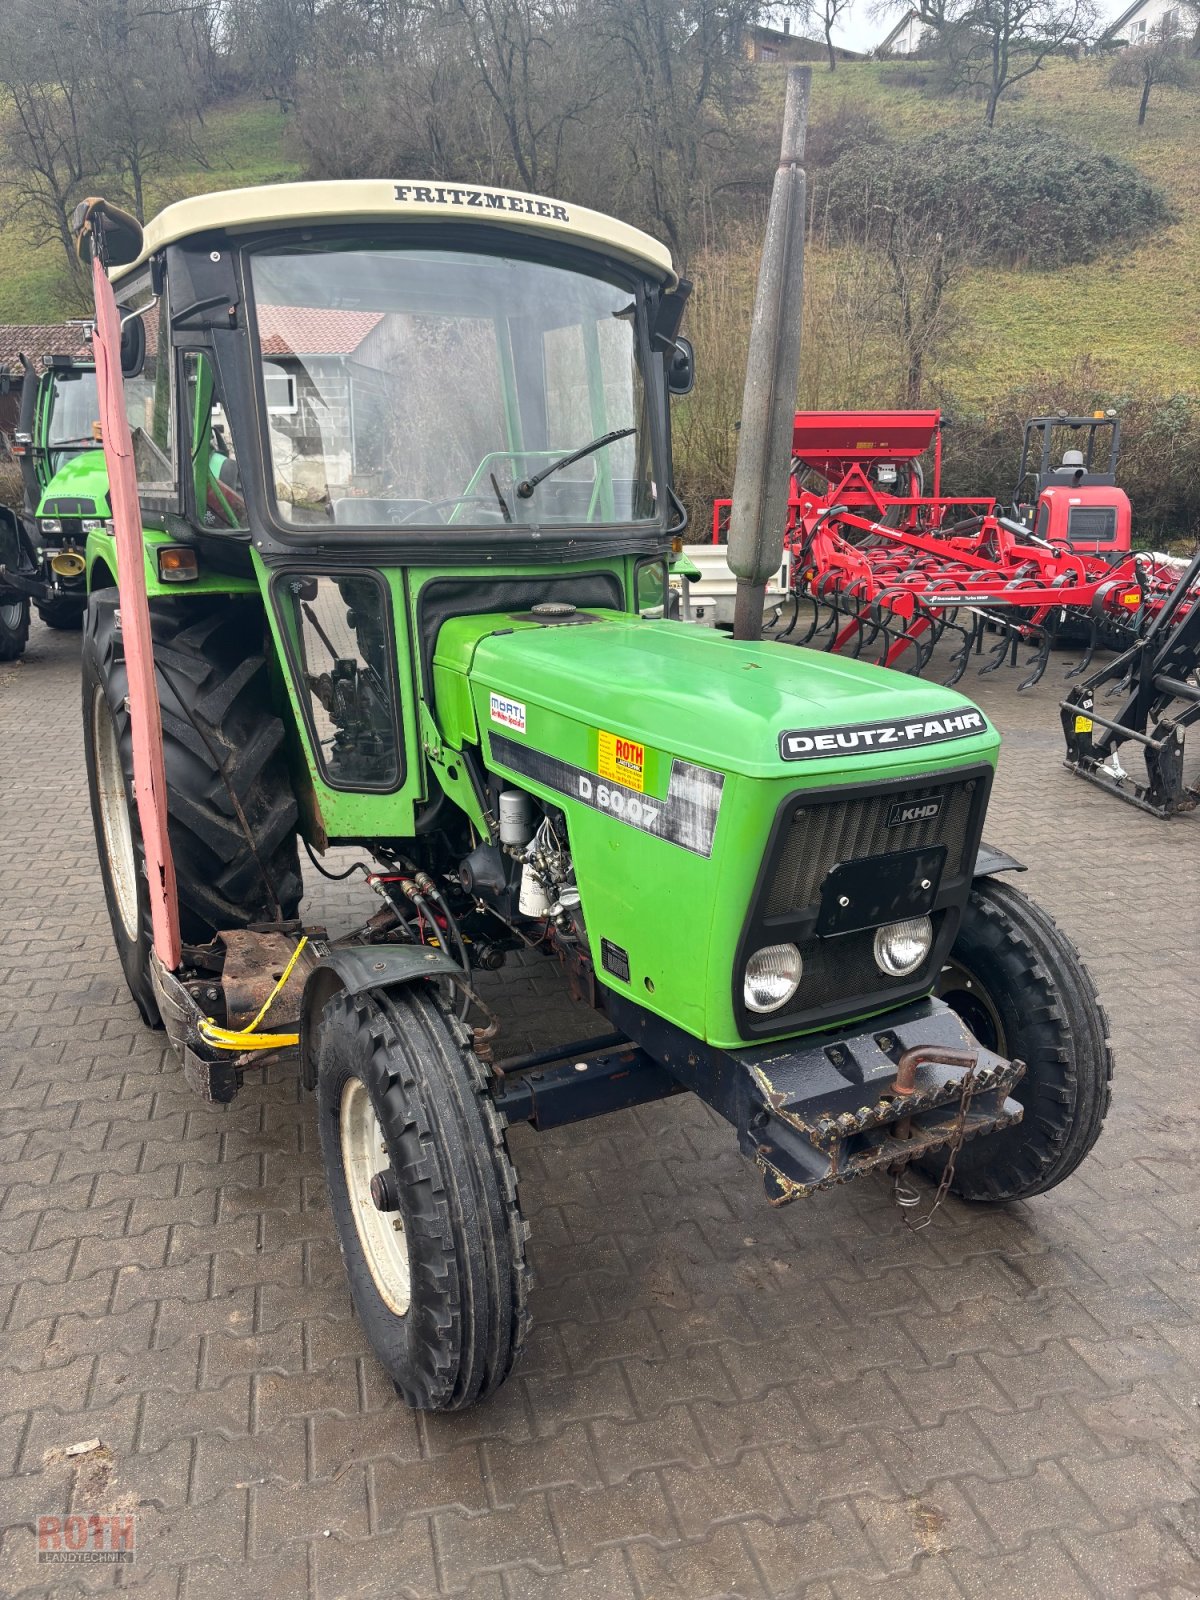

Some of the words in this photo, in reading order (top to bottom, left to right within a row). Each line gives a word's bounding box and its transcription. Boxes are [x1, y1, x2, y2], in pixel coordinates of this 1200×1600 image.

[394, 185, 570, 222] FRITZMEIER
[787, 712, 983, 753] DEUTZ-FAHR
[616, 738, 643, 766] ROTH
[578, 775, 592, 799] D
[901, 805, 938, 821] KHD
